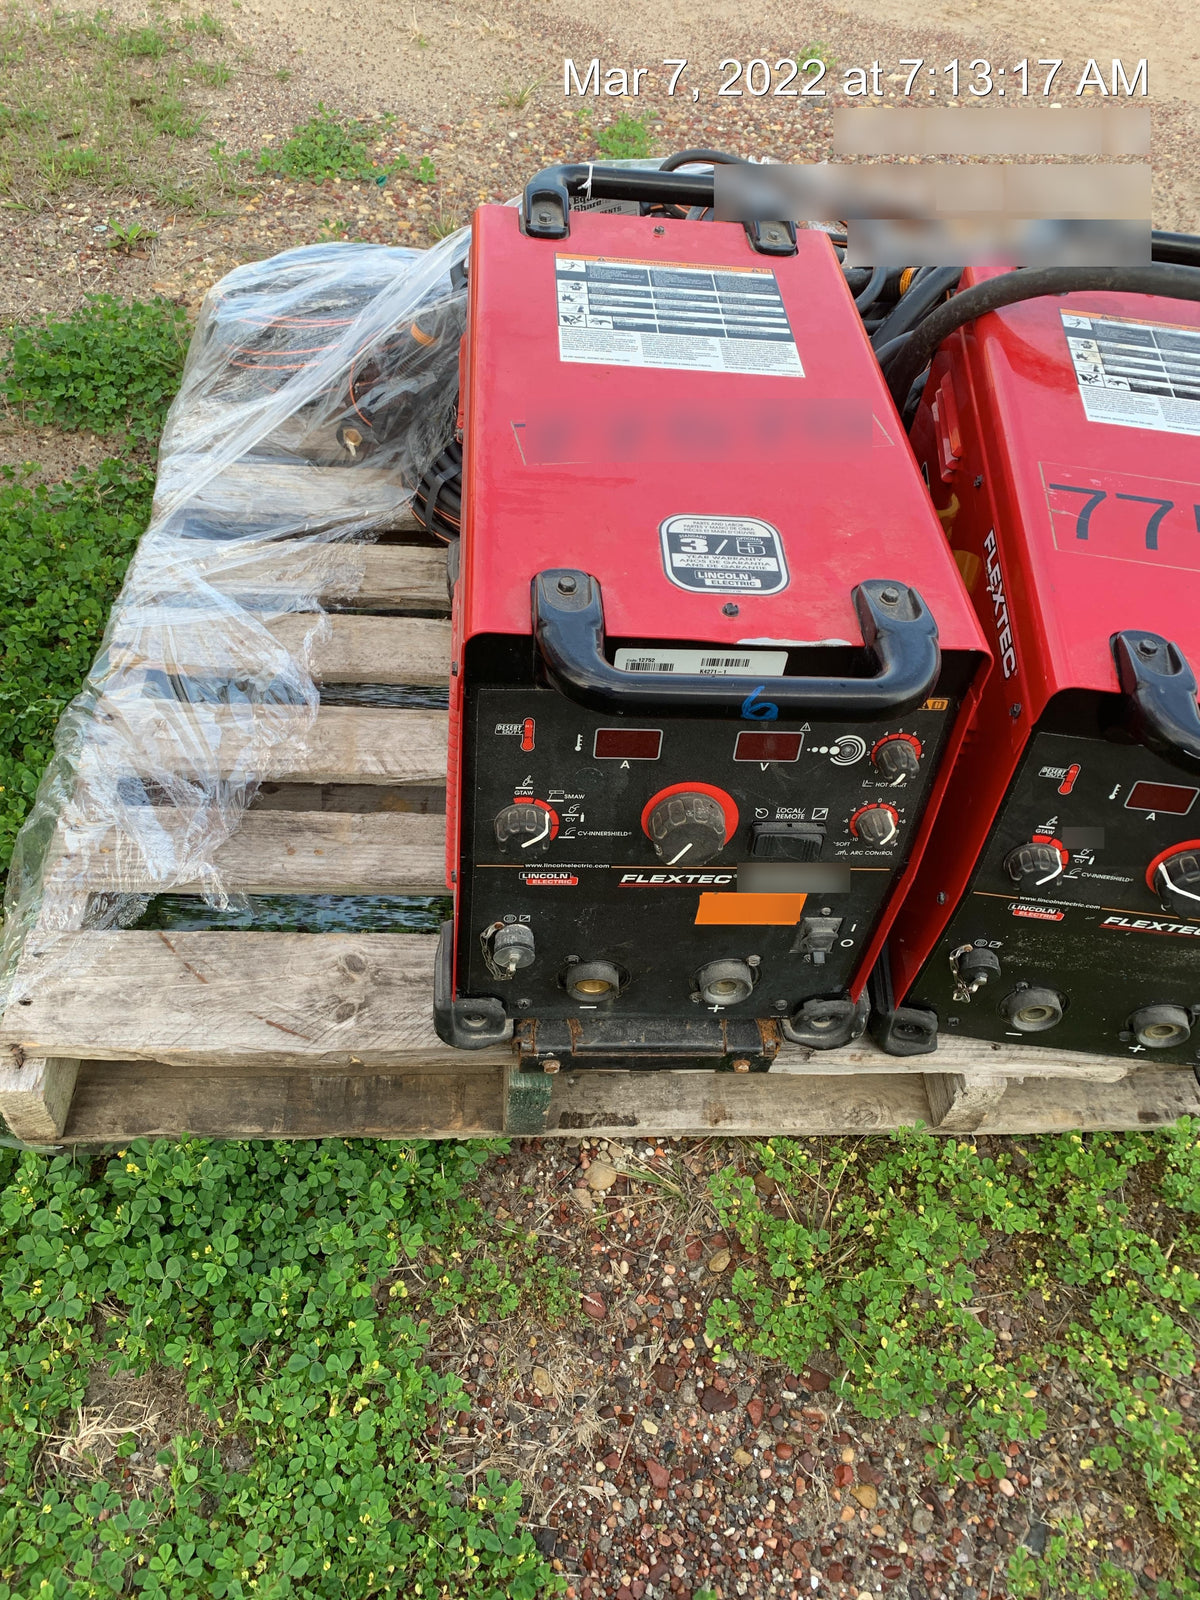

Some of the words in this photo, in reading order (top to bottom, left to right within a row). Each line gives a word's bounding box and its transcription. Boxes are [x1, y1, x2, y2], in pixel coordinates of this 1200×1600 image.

[1049, 483, 1200, 550] 77
[697, 571, 749, 580] LINCOLN
[984, 529, 1016, 679] FLEXTEC
[742, 685, 779, 721] 6
[619, 760, 630, 769] A
[760, 762, 769, 771] V
[1145, 812, 1156, 821] A
[1019, 895, 1101, 910] www.lincolnelectric.com
[1011, 904, 1057, 914] LINCOLN
[1018, 911, 1058, 920] ELECTRIC
